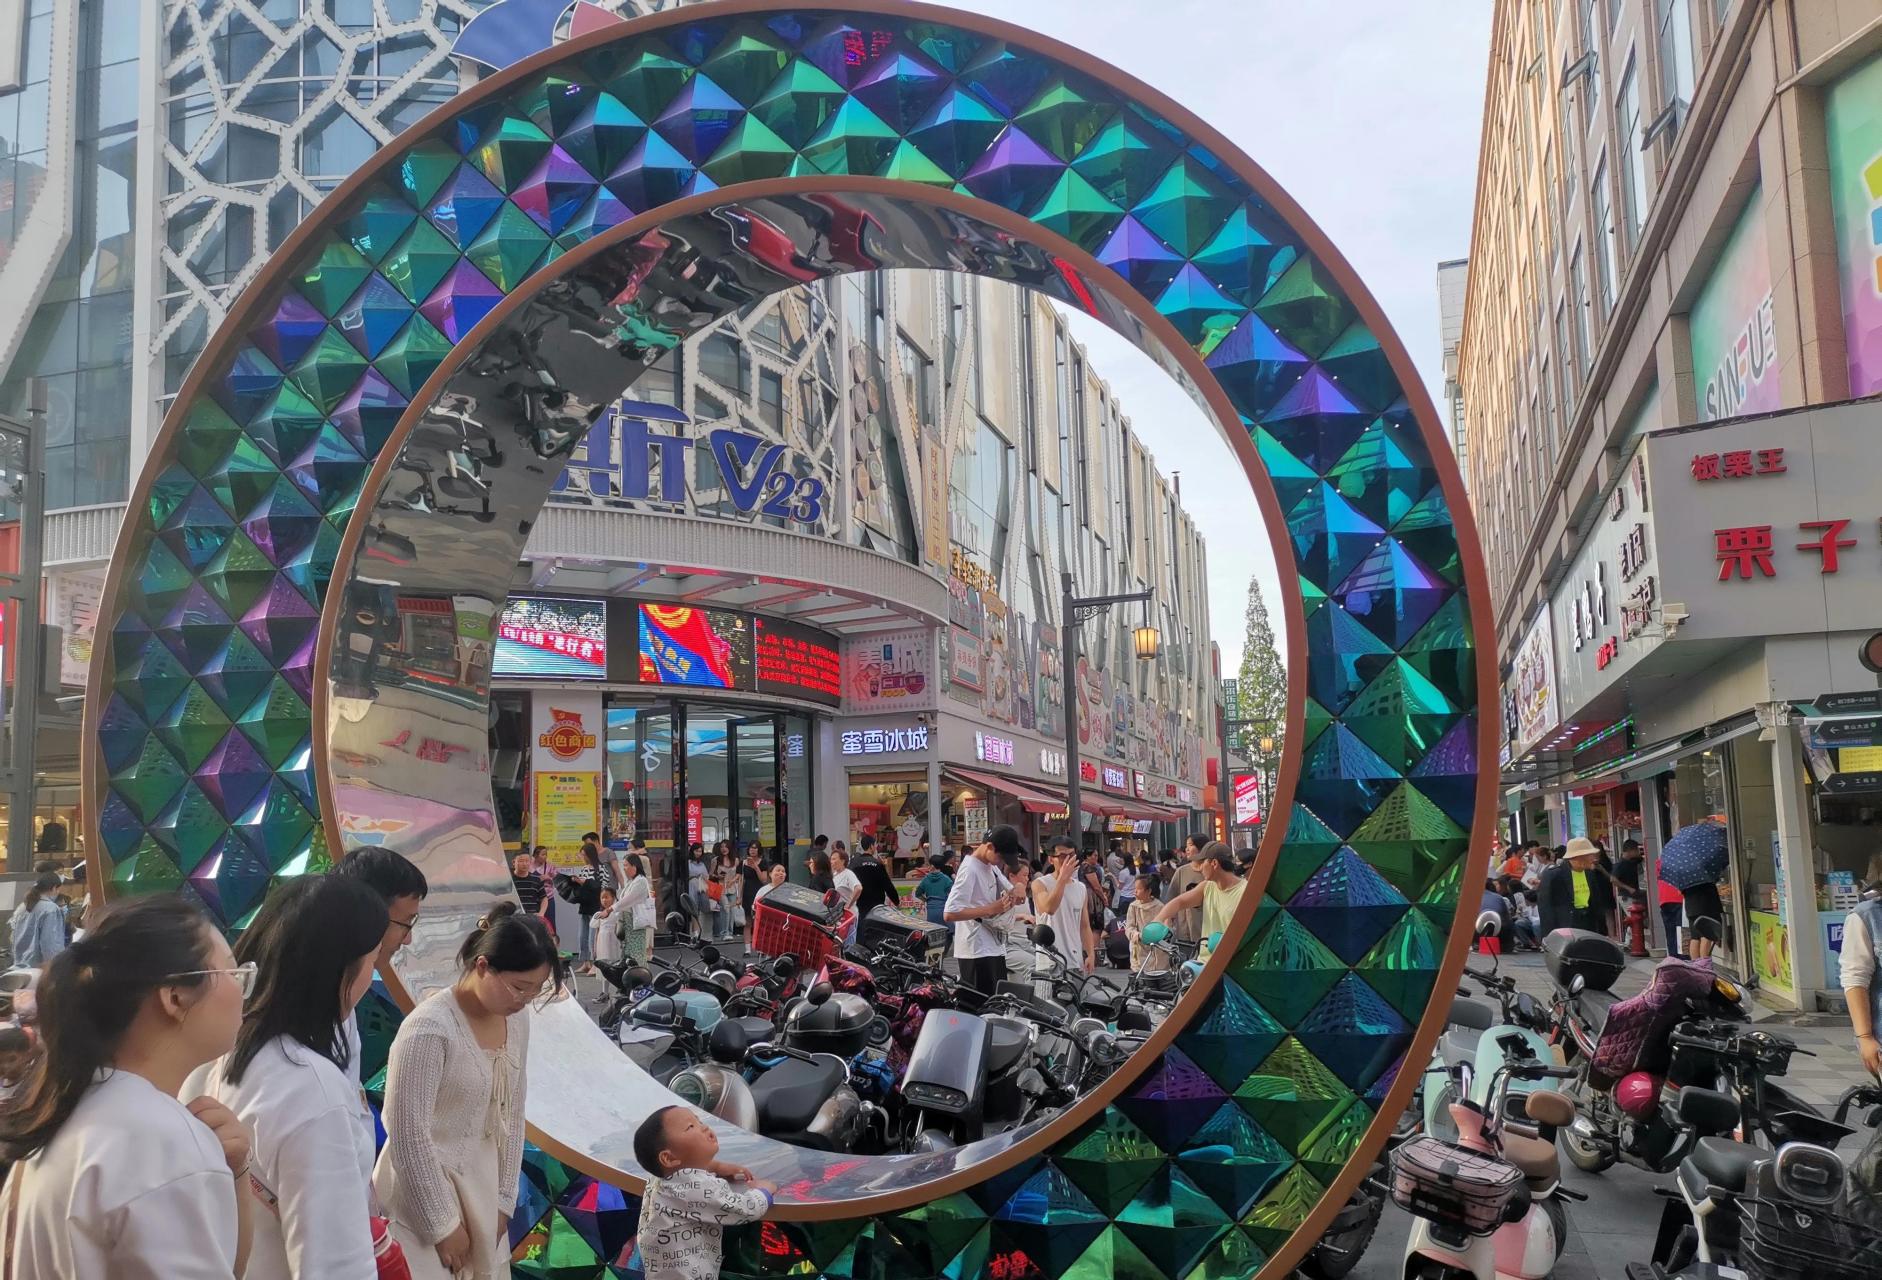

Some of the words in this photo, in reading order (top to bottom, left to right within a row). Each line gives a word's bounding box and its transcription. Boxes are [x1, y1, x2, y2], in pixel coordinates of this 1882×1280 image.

[709, 429, 823, 523] V23
[1691, 448, 1787, 481] 板栗王
[1713, 517, 1882, 581] 栗子
[841, 727, 928, 754] 蜜雪冰城
[657, 1226, 705, 1245] STOR
